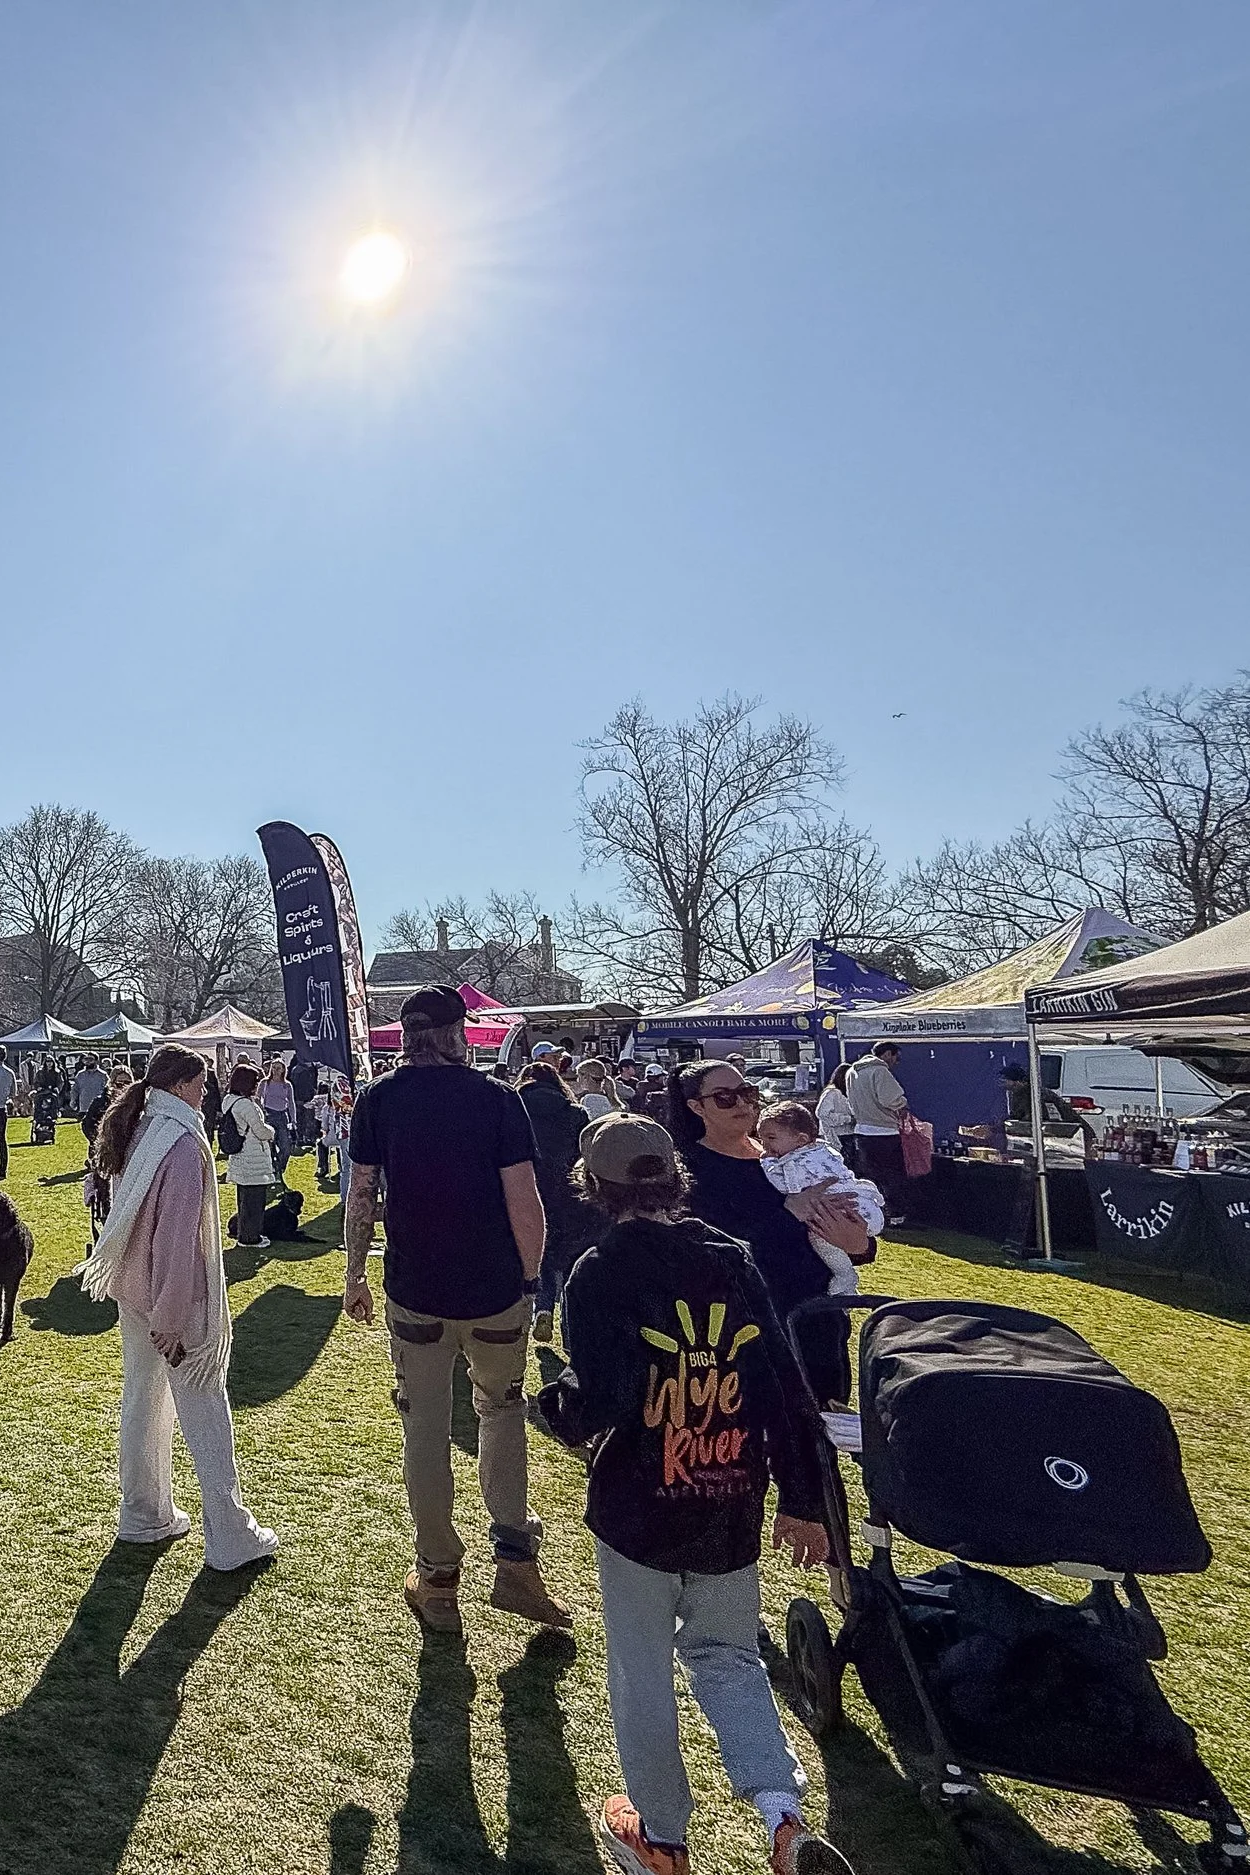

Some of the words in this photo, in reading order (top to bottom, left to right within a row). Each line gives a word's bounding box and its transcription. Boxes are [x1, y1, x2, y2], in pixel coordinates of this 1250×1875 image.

[276, 867, 317, 890] KILDERKIN
[285, 904, 319, 923] Craft
[304, 934, 312, 945] &
[1091, 990, 1118, 1012] GIN
[651, 1021, 685, 1029] MOBILE
[686, 1020, 724, 1028] CANNOLI
[727, 1019, 746, 1027] BAR
[746, 1019, 756, 1027] &
[758, 1018, 789, 1027] MORE
[918, 1019, 967, 1031] Blueberries
[1100, 1187, 1174, 1239] Larrikin
[1226, 1202, 1250, 1218] KIL
[689, 1351, 718, 1367] BIG4
[643, 1350, 743, 1435] Wye
[664, 1421, 749, 1486] River
